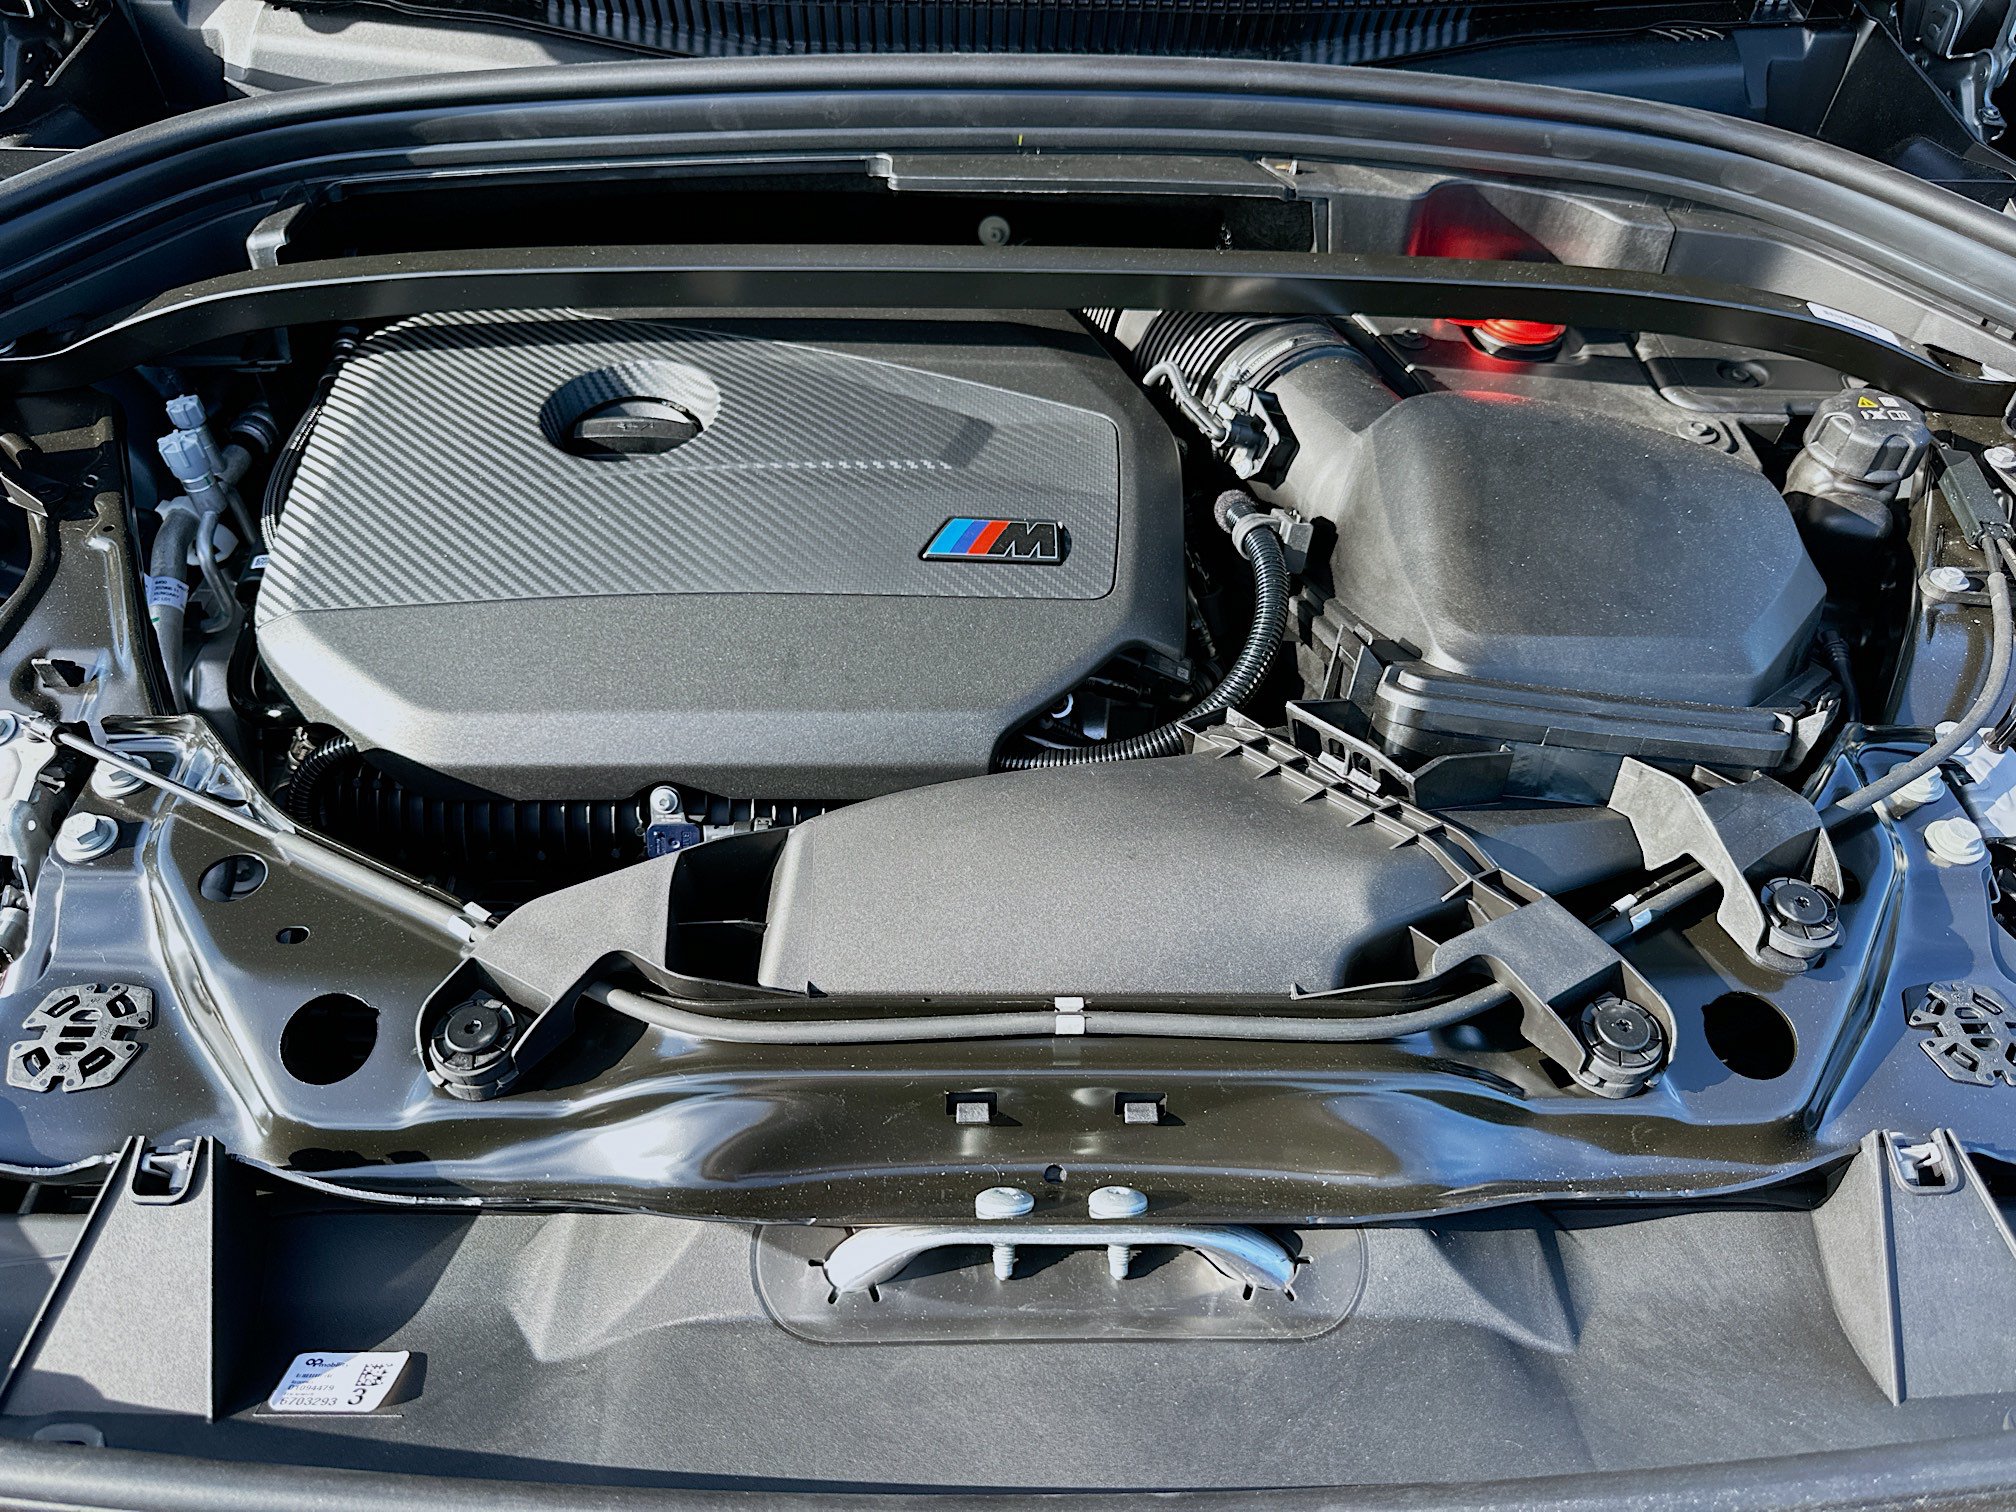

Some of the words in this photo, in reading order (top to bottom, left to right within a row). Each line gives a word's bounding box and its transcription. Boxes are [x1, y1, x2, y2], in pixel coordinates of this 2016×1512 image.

[986, 521, 1058, 559] M
[279, 1396, 338, 1406] 6703293
[347, 1388, 367, 1405] 3
